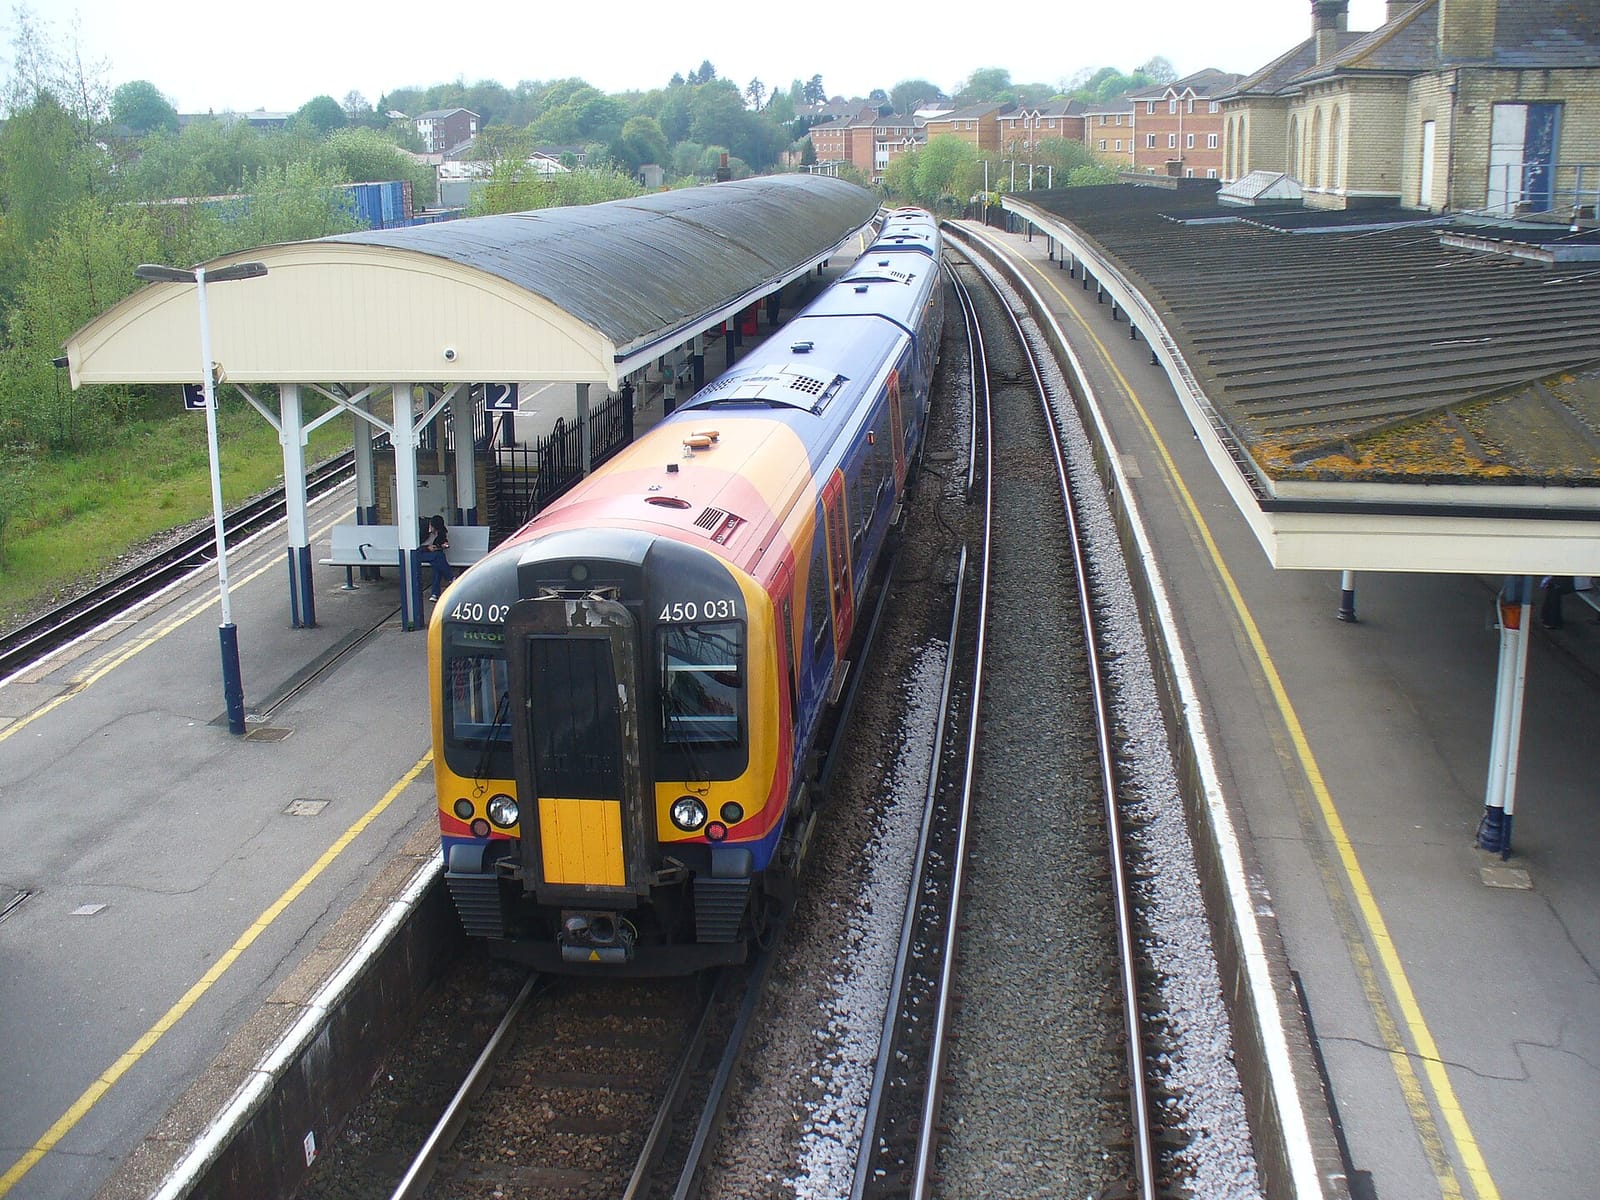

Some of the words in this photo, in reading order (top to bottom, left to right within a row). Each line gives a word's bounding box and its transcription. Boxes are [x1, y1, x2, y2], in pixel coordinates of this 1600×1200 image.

[192, 383, 206, 407] 3
[494, 383, 512, 408] 2
[451, 602, 483, 621] 450
[488, 604, 510, 623] 03
[659, 602, 698, 622] 450
[703, 599, 736, 619] 031
